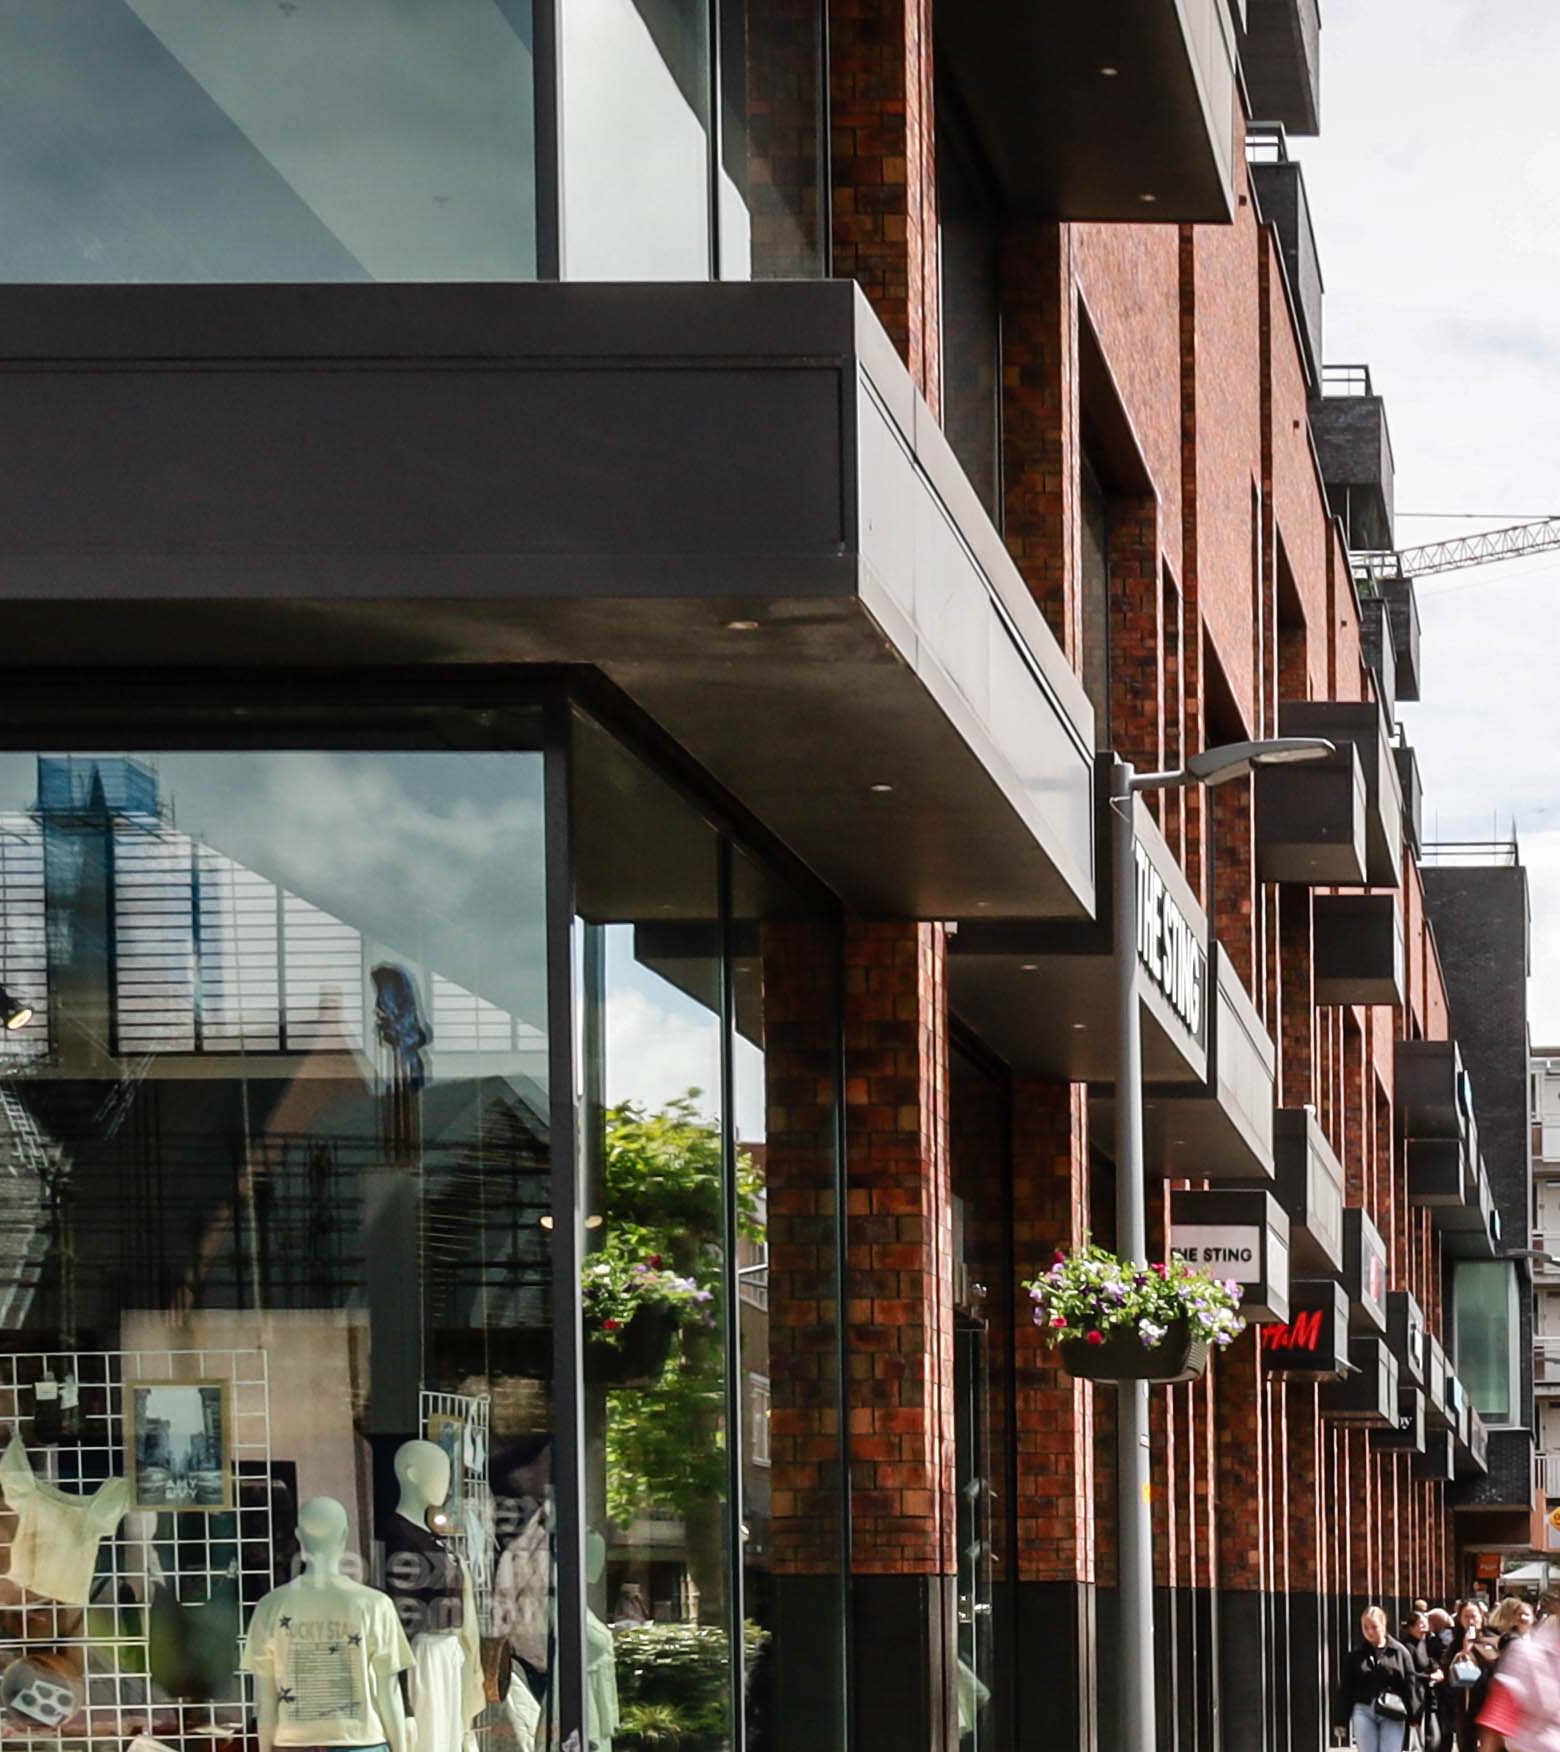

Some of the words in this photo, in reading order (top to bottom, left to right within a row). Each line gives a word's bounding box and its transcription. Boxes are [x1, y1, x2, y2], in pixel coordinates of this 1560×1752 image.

[1135, 839, 1163, 981] THE
[1162, 891, 1200, 1034] STING
[1203, 1248, 1252, 1262] STING
